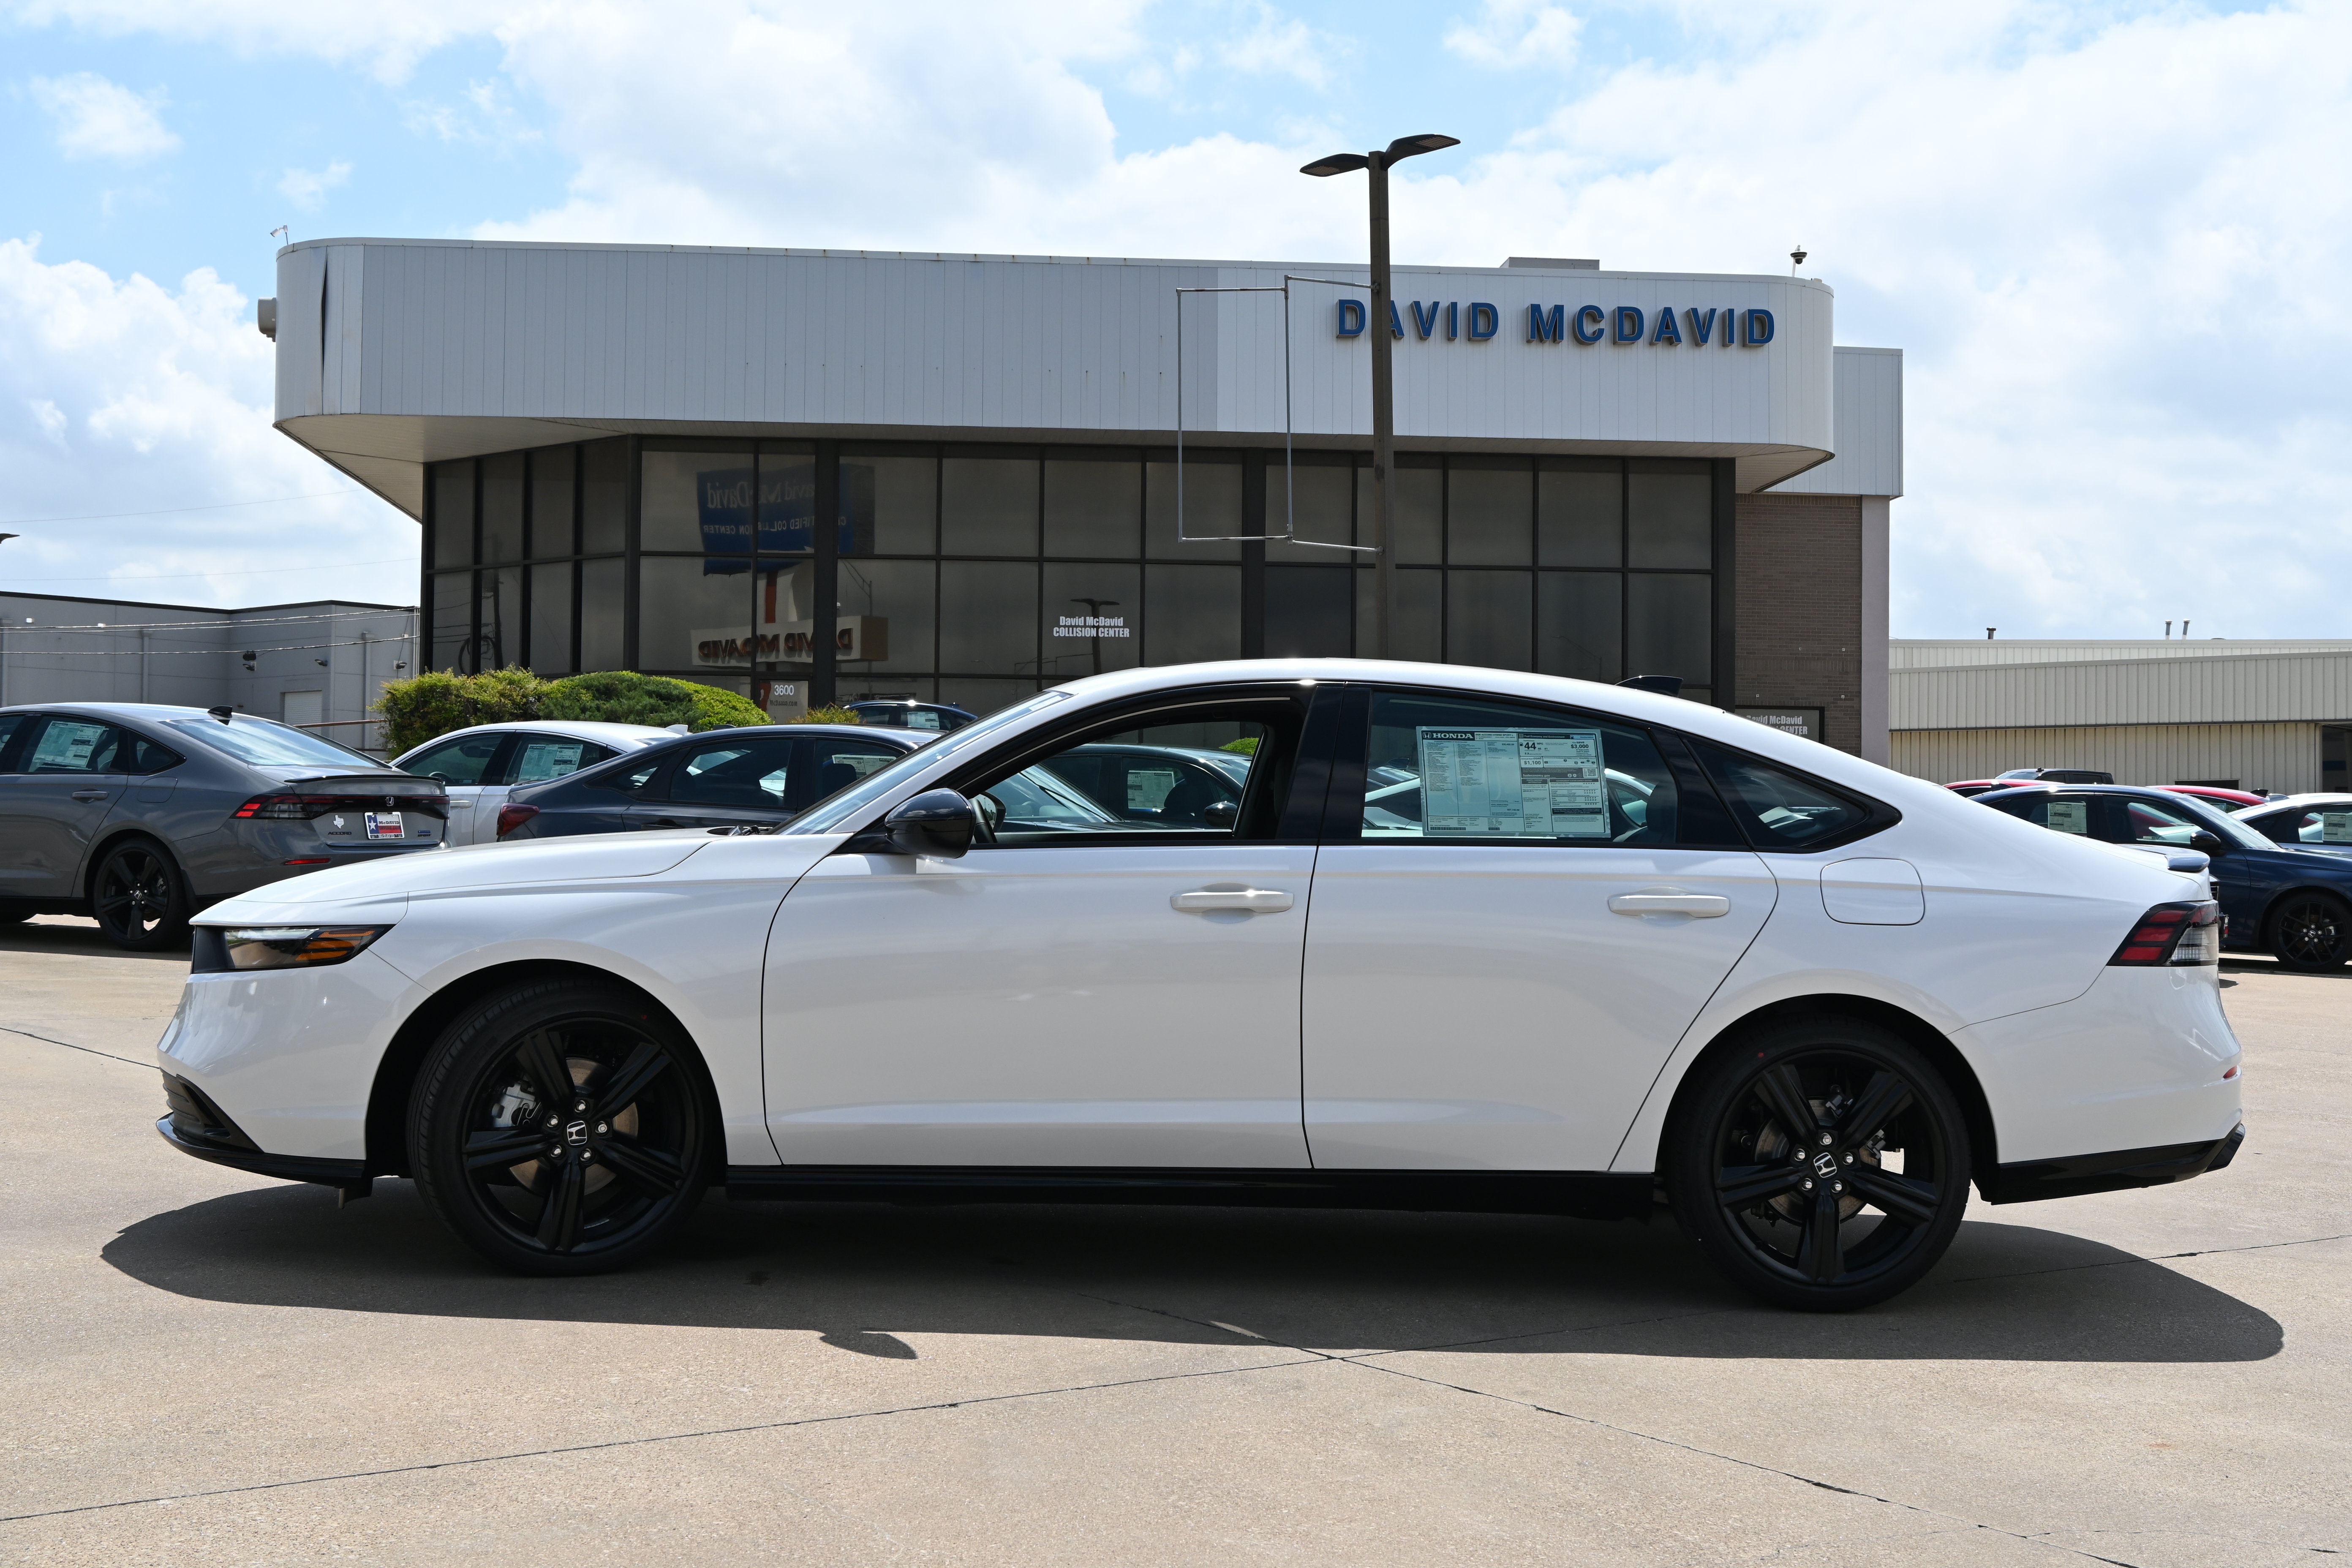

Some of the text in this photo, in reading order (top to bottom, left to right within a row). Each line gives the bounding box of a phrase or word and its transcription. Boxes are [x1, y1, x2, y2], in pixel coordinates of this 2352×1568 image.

[1526, 303, 1774, 347] MCDAVID
[1059, 616, 1124, 626] David McDavid
[1053, 627, 1130, 637] COLLISION CENTER
[774, 685, 794, 696] 3600
[1769, 716, 1802, 724] McDavid
[1524, 742, 1536, 750] 44
